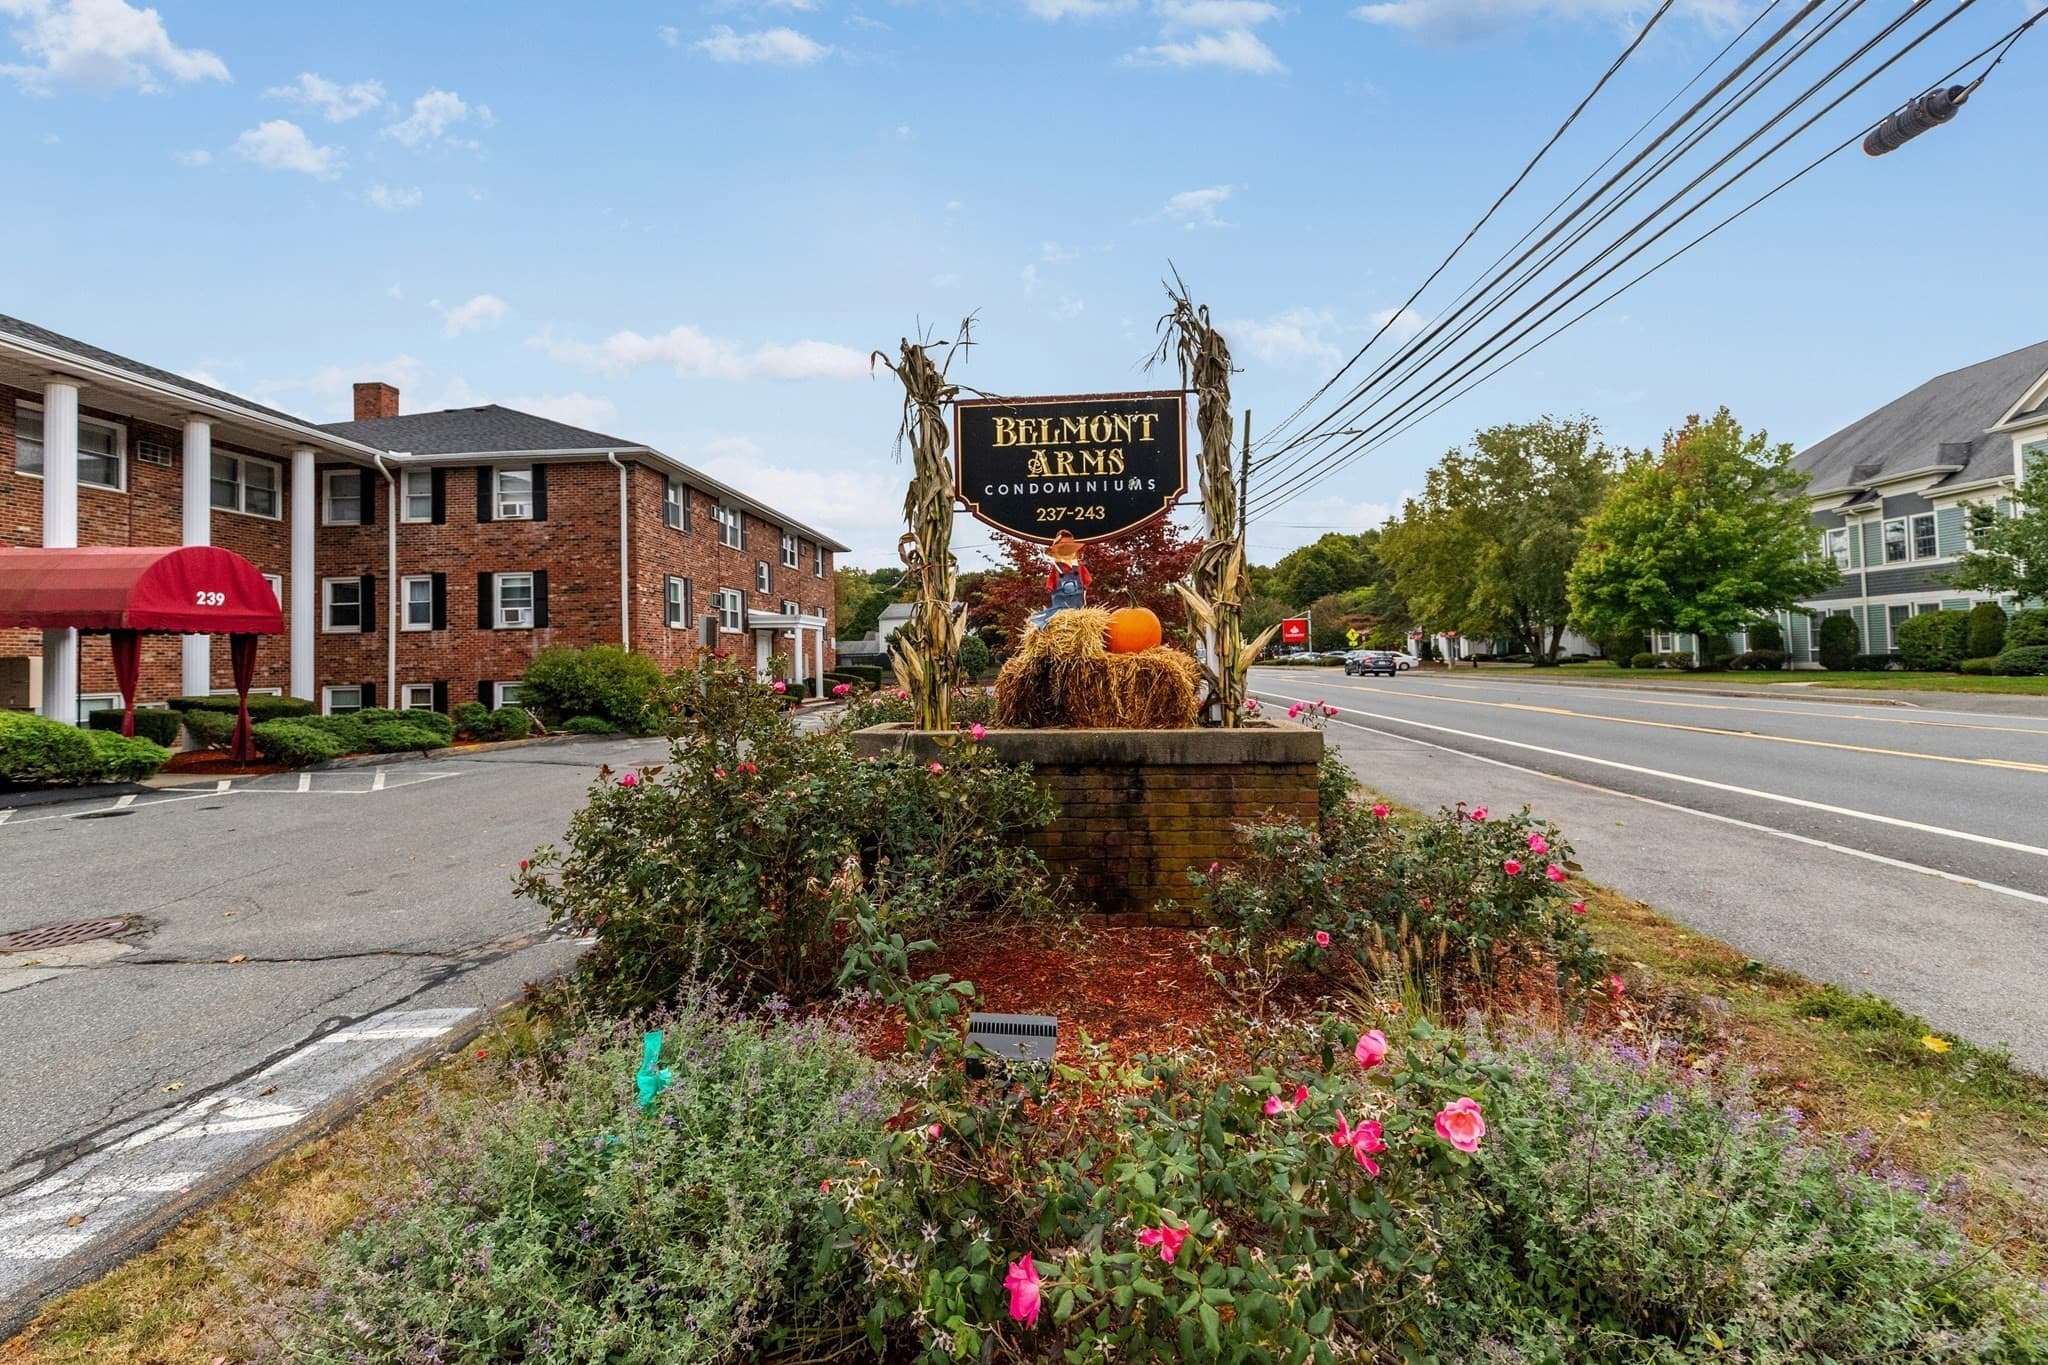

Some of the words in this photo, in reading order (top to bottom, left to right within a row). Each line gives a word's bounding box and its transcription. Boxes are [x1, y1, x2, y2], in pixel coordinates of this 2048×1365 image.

[992, 414, 1159, 447] BELMONT
[1026, 448, 1125, 478] ARMS
[984, 478, 1156, 496] CONDOMINIUMS
[1036, 506, 1106, 522] 237-243
[196, 591, 225, 606] 239
